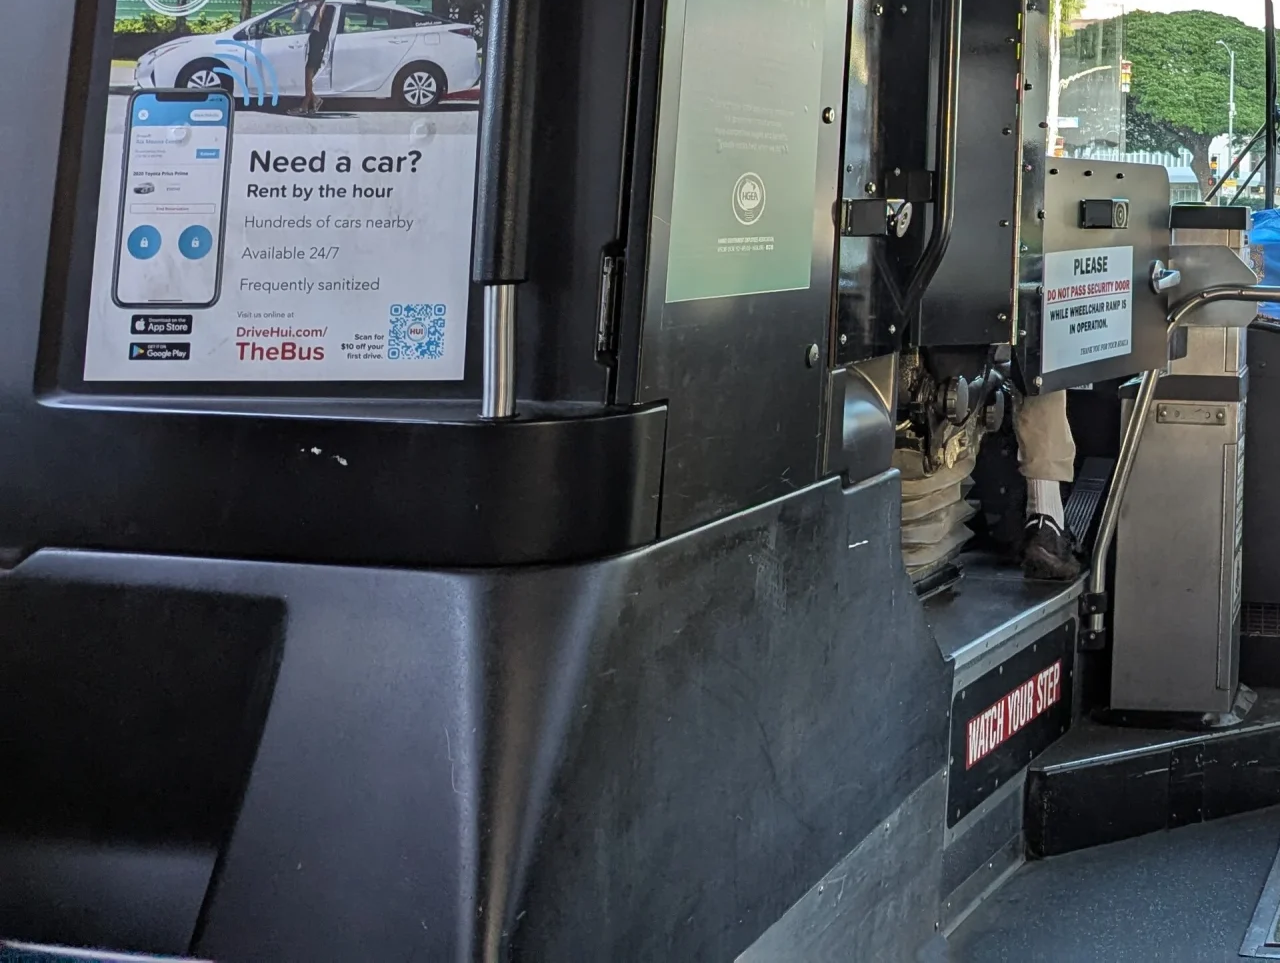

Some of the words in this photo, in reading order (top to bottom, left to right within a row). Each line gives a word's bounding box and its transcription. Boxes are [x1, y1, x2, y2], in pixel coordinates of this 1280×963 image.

[250, 150, 326, 173] Need
[336, 156, 351, 173] a
[362, 150, 422, 173] car?
[247, 184, 286, 198] Rent
[292, 184, 313, 201] by
[319, 184, 346, 198] the
[353, 184, 393, 198] hour
[743, 192, 758, 201] HGEA
[245, 215, 312, 229] Hundreds
[316, 215, 331, 229] of
[335, 218, 361, 228] cars
[366, 215, 414, 231] nearby
[241, 247, 305, 260] Available
[309, 246, 340, 260] 24/7
[1074, 256, 1108, 275] PLEASE
[240, 278, 314, 294] Frequently
[318, 278, 380, 290] sanitized
[1048, 290, 1056, 301] DO
[1058, 287, 1069, 300] NOT
[1071, 285, 1086, 297] PASS
[1088, 282, 1114, 294] SECURITY
[1115, 280, 1130, 291] DOOR
[1050, 308, 1068, 321] WHILE
[1070, 303, 1104, 317] WHEELCHAIR
[1106, 300, 1120, 312] RAMP
[1122, 300, 1126, 309] IS
[148, 322, 164, 332] App
[166, 322, 188, 332] Store
[236, 327, 328, 338] DriveHui.com/
[1070, 324, 1075, 334] IN
[1077, 319, 1108, 332] OPERATION.
[147, 348, 171, 359] Google
[173, 348, 187, 358] Play
[236, 342, 324, 361] TheBus
[348, 352, 361, 360] first
[363, 352, 383, 360] drive.
[969, 700, 1004, 765] WATCH
[1008, 681, 1034, 735] YOUR
[1037, 663, 1060, 713] STEP
